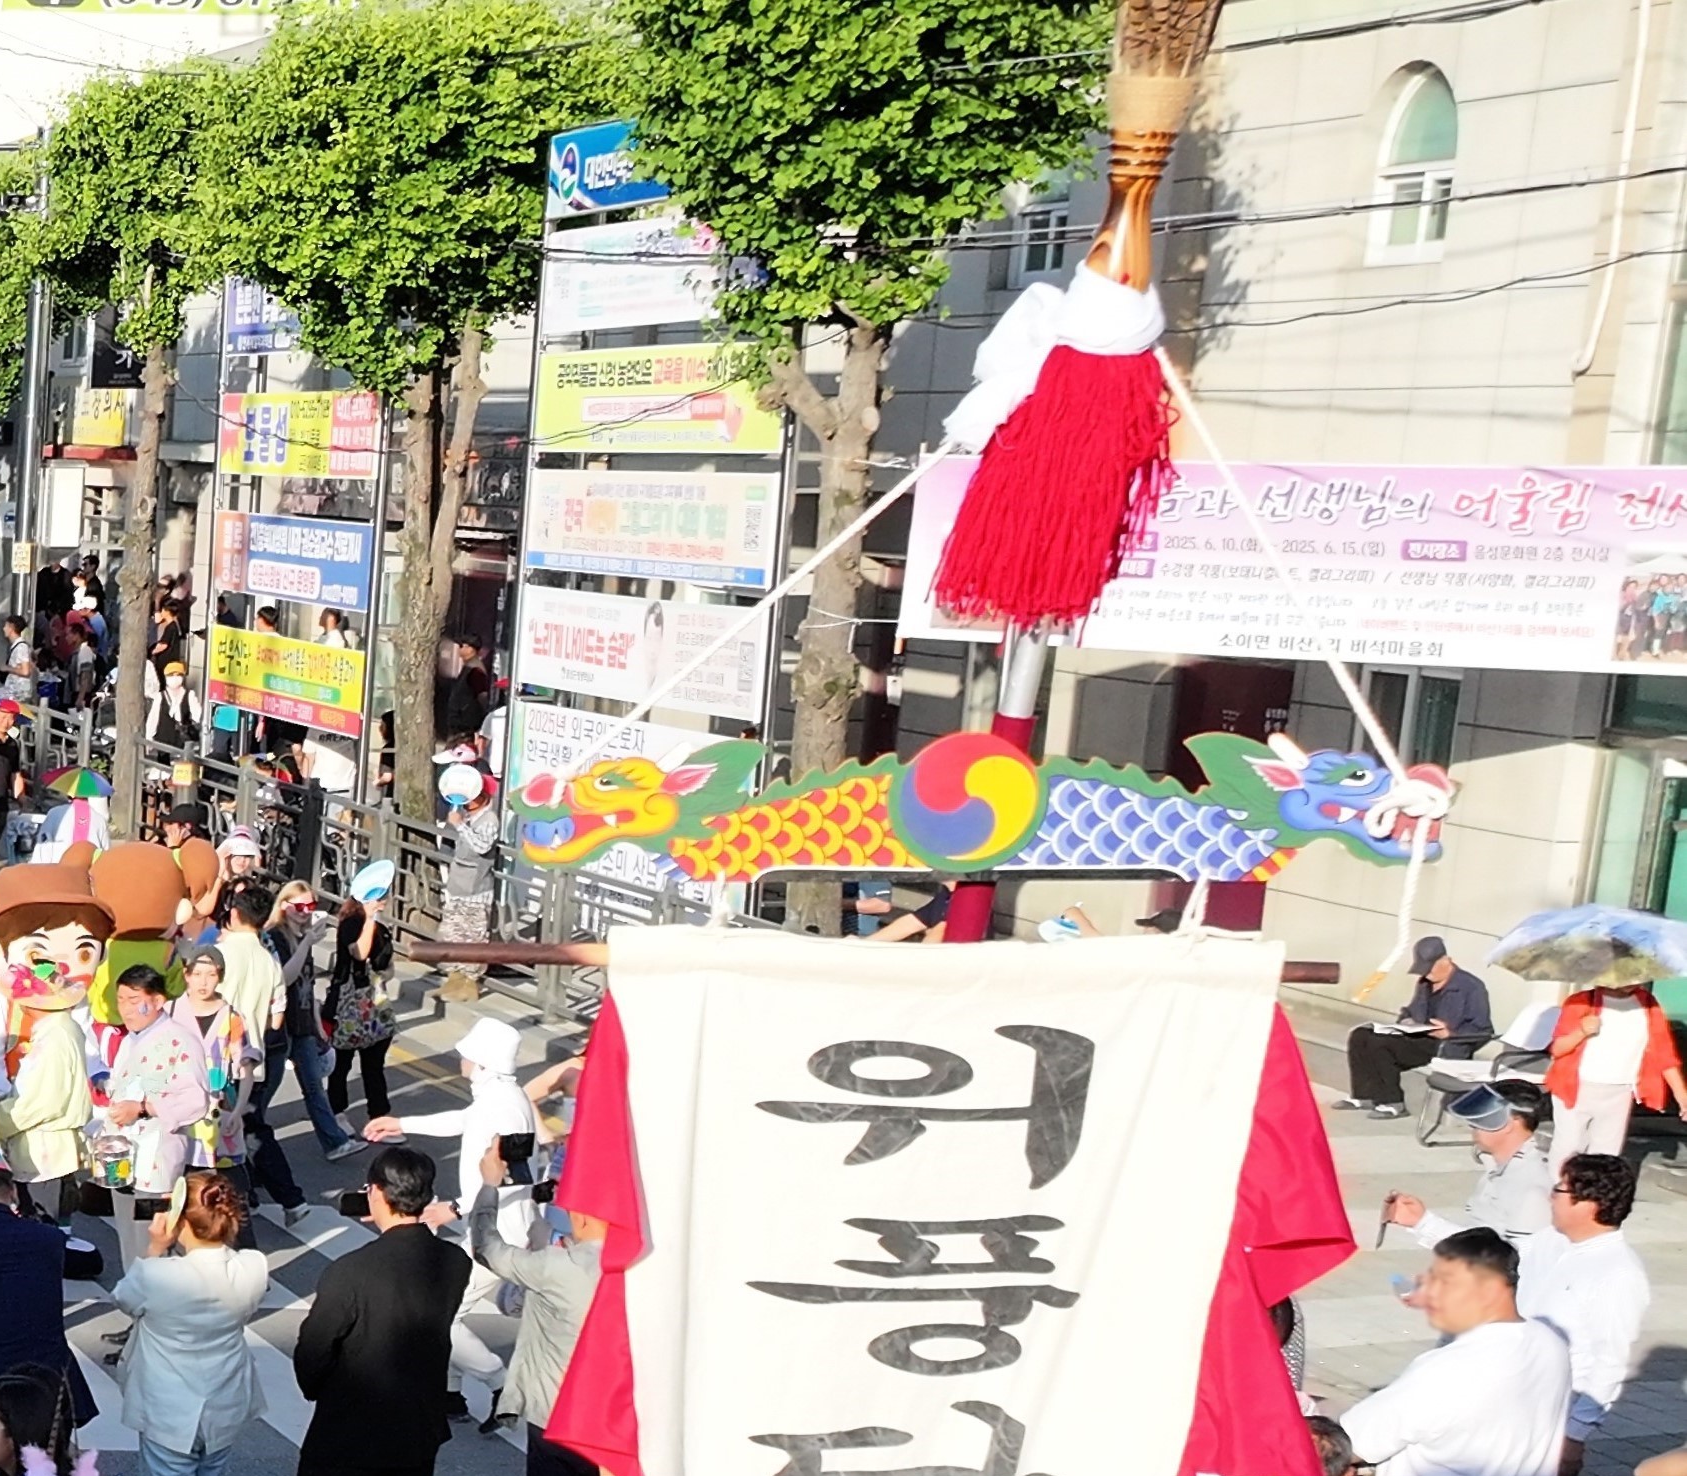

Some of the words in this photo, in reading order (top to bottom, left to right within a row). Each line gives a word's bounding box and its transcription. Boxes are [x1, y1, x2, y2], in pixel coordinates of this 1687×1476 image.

[1454, 475, 1592, 532] 어울림
[1571, 547, 1610, 563] 전시실
[566, 626, 604, 666] 나이드는
[1219, 633, 1270, 649] 소이면
[1351, 639, 1443, 658] 비석마을회
[528, 709, 567, 739] 2025년
[571, 719, 645, 754] 외국인로자
